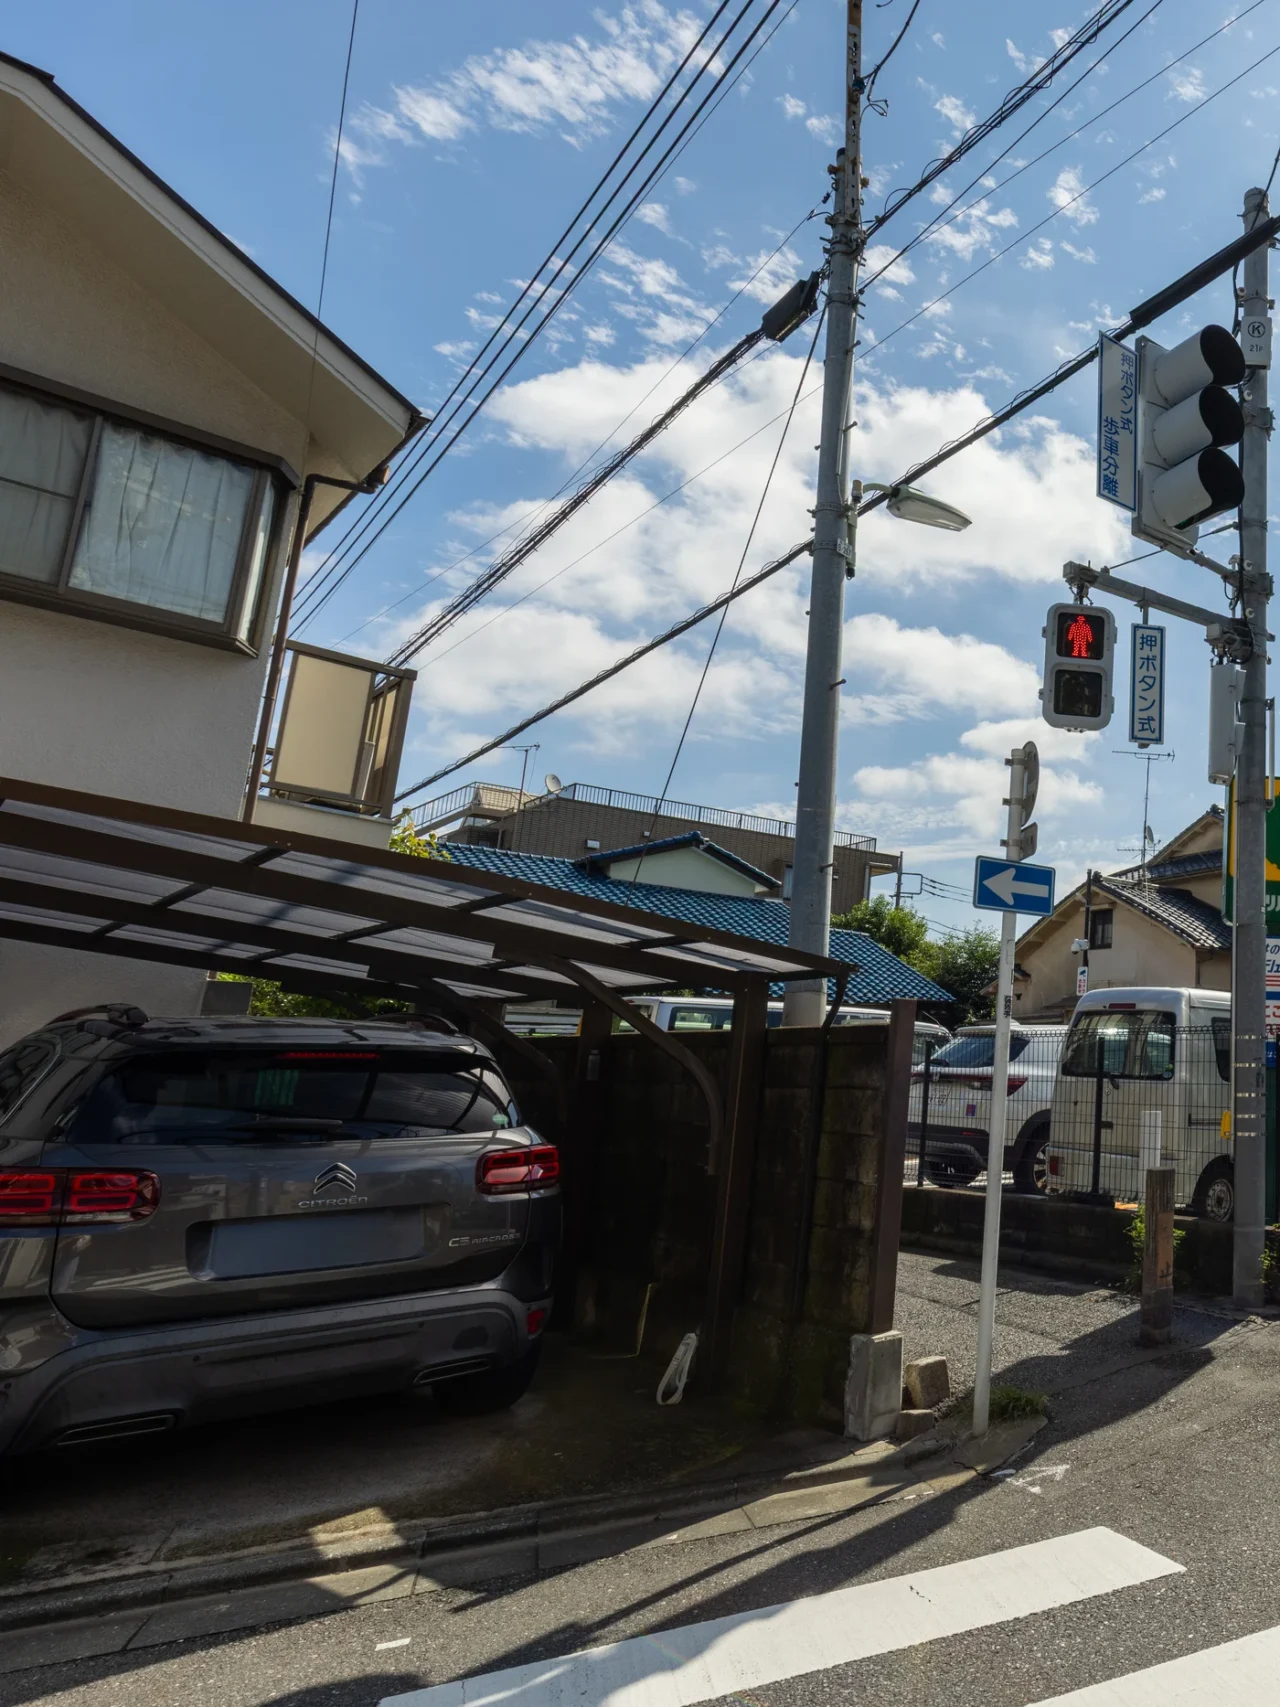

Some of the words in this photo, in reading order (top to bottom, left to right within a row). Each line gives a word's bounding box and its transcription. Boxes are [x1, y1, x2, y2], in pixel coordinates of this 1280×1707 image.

[1119, 351, 1134, 435] 押ボタン式
[1102, 415, 1120, 498] 歩車分離
[1138, 633, 1158, 734] 押ボタン式
[448, 1236, 471, 1247] C5
